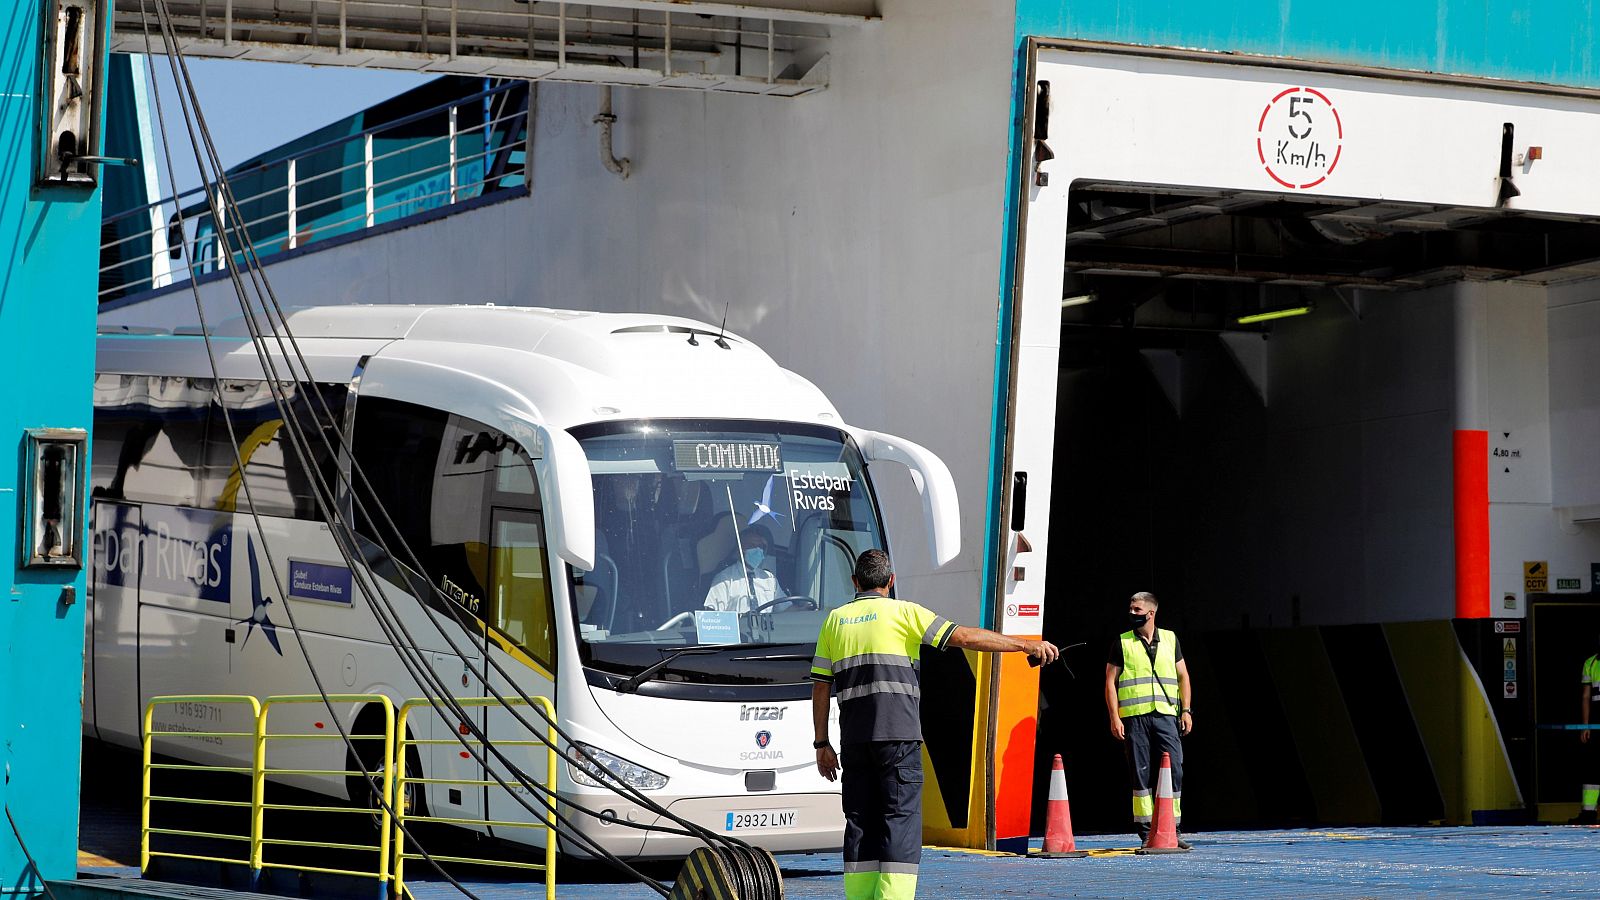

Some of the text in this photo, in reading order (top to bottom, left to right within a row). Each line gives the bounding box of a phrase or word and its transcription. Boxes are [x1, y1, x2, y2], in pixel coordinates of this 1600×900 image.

[1288, 96, 1314, 140] 5
[1276, 139, 1326, 169] Km/h
[789, 469, 852, 492] Esteban
[793, 490, 836, 511] Rivas
[1526, 580, 1547, 588] CCTV
[194, 704, 208, 720] 937
[209, 706, 222, 722] 711
[740, 750, 784, 761] SCANIA
[735, 812, 795, 828] 2932 LNY
